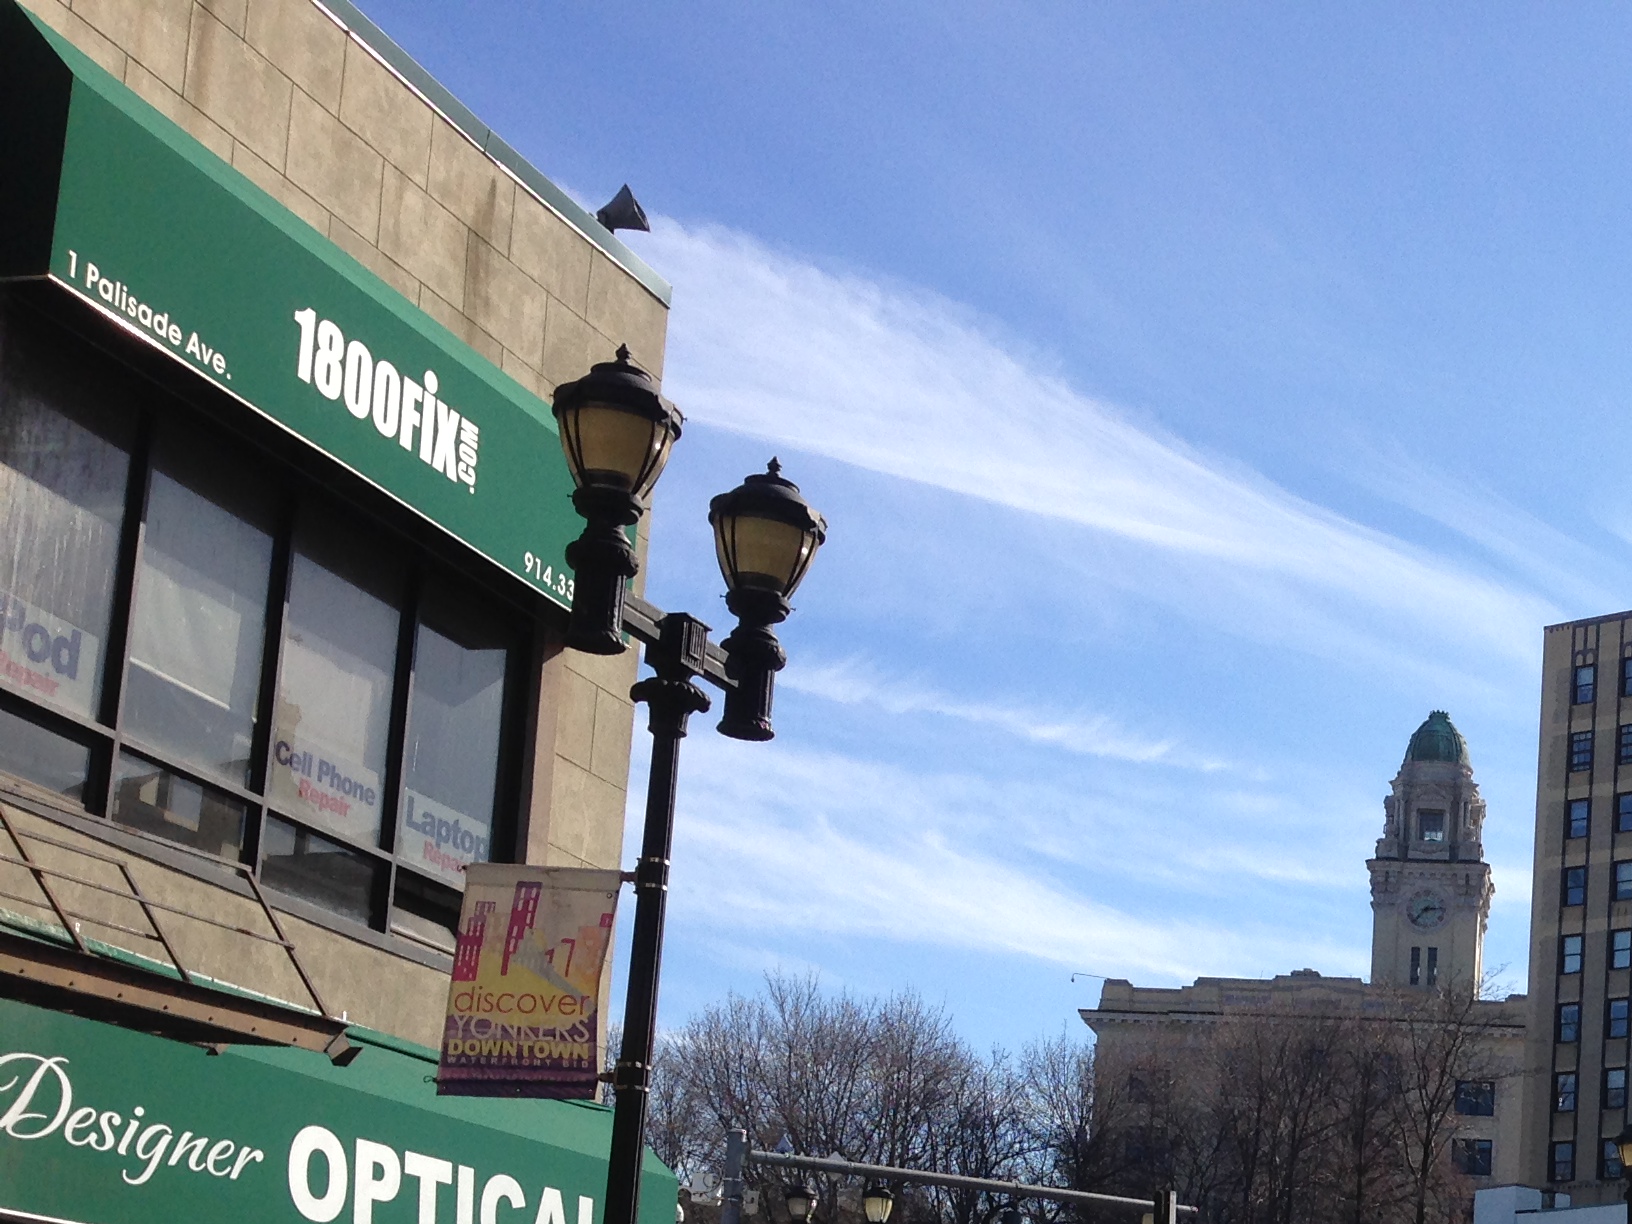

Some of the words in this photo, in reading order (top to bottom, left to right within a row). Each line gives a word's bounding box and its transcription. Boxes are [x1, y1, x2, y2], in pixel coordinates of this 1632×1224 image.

[68, 249, 78, 279] 1
[86, 262, 183, 346] Palisade
[185, 331, 232, 380] Ave.
[275, 740, 314, 777] Cell
[317, 758, 376, 806] Phone
[298, 778, 351, 818] Repair
[454, 985, 591, 1016] discover
[447, 1056, 551, 1066] WATERFRONT
[448, 1039, 590, 1060] DOWNTOWN
[0, 1052, 265, 1186] Designer
